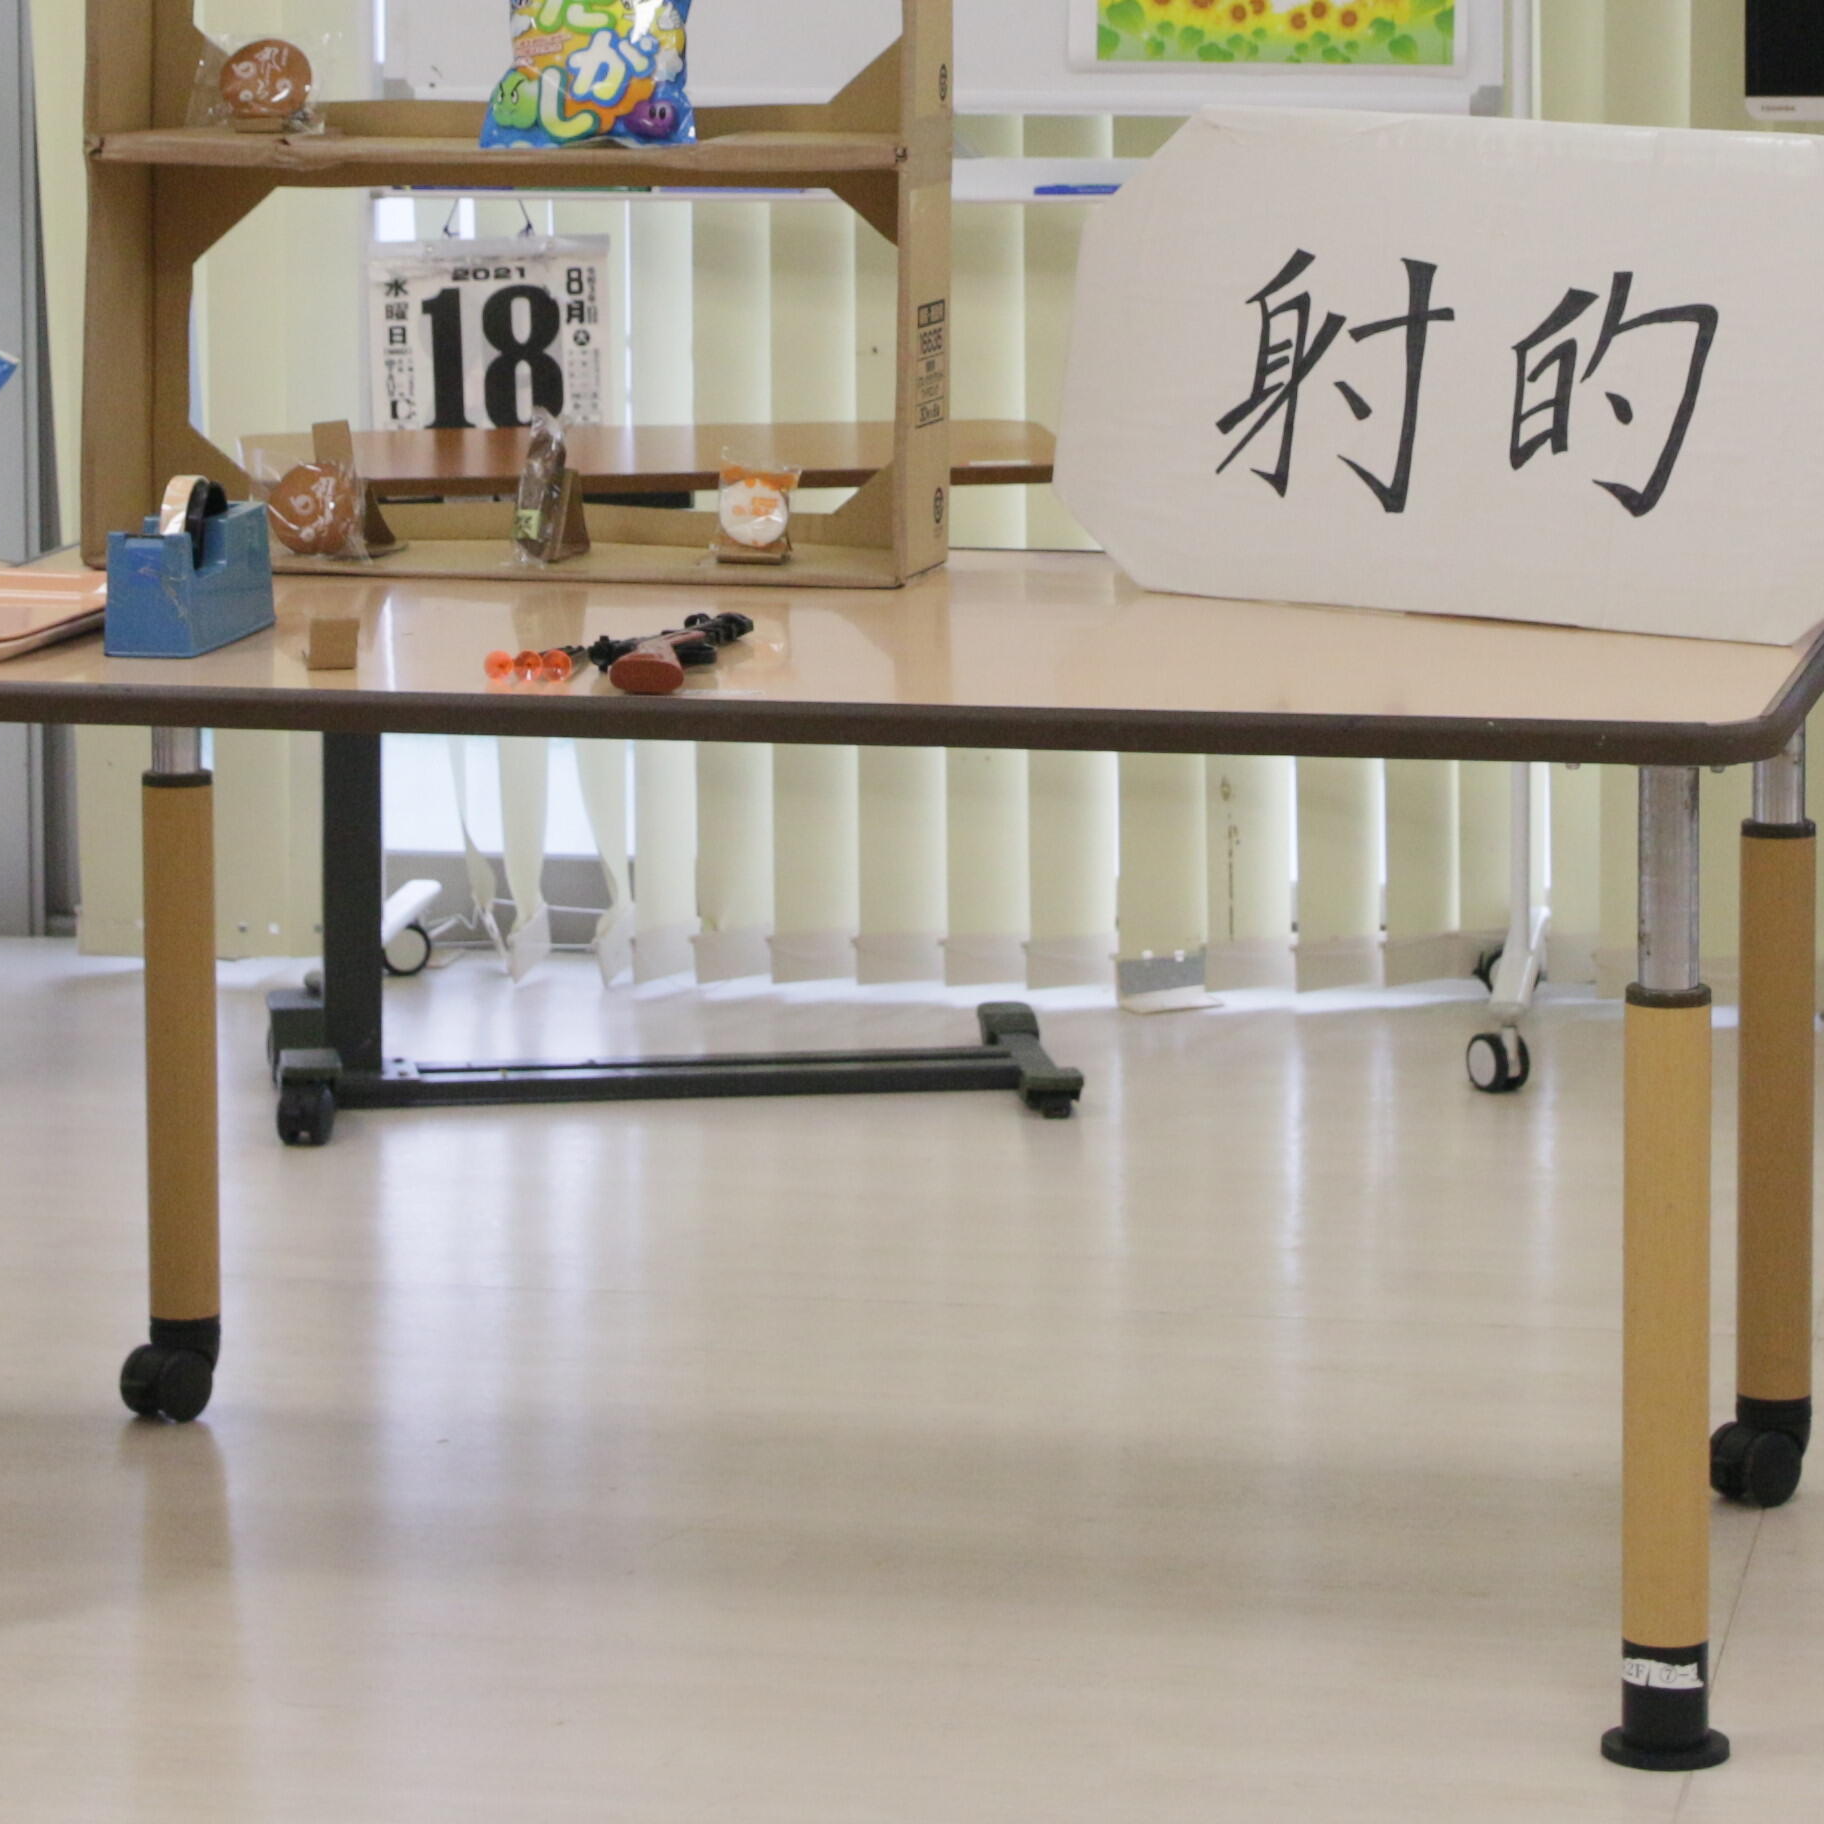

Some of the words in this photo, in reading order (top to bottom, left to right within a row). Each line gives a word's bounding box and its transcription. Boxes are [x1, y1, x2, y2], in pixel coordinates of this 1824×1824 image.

[451, 266, 526, 282] 2021
[566, 267, 585, 324] 8月
[385, 277, 409, 346] 水曜日
[421, 283, 565, 429] 18
[1215, 248, 1719, 518] 射的
